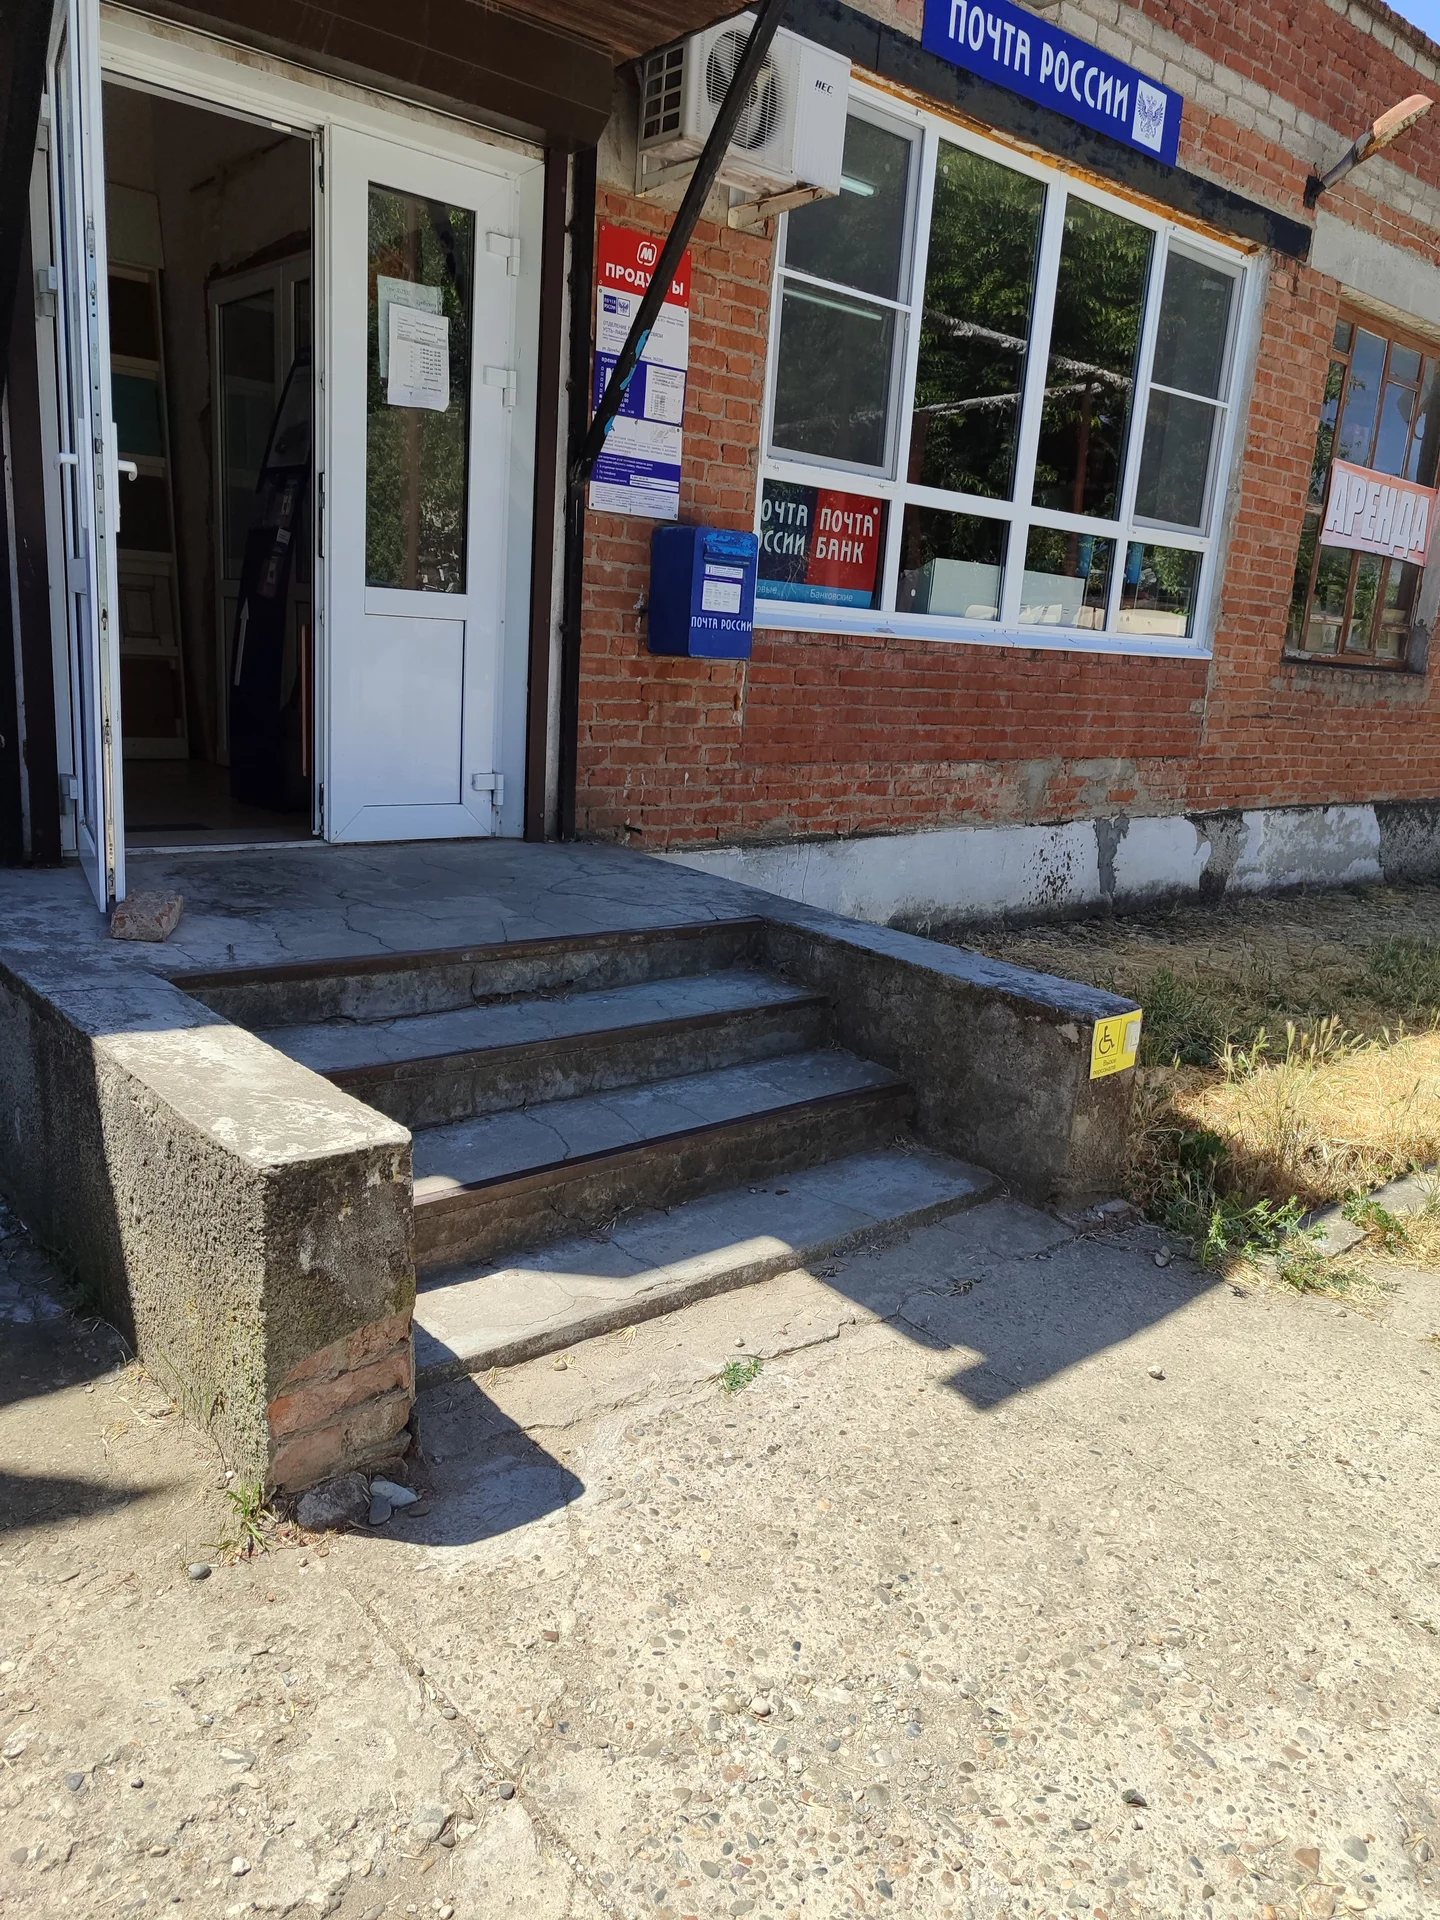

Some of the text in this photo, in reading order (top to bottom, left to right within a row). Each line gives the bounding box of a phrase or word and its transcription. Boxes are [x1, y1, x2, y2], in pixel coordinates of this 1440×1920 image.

[948, 0, 1129, 122] ПОЧТА РОССИИ
[605, 262, 684, 296] ПРОДУЫ
[761, 499, 808, 527] ОЧТА
[820, 508, 873, 537] ПОЧТА
[1325, 470, 1430, 559] АРЕНДА
[759, 529, 806, 556] ССИИ
[816, 537, 863, 564] БАНК
[757, 585, 853, 602] овые Банковские
[691, 616, 752, 632] ПОЧТА РОССИИ
